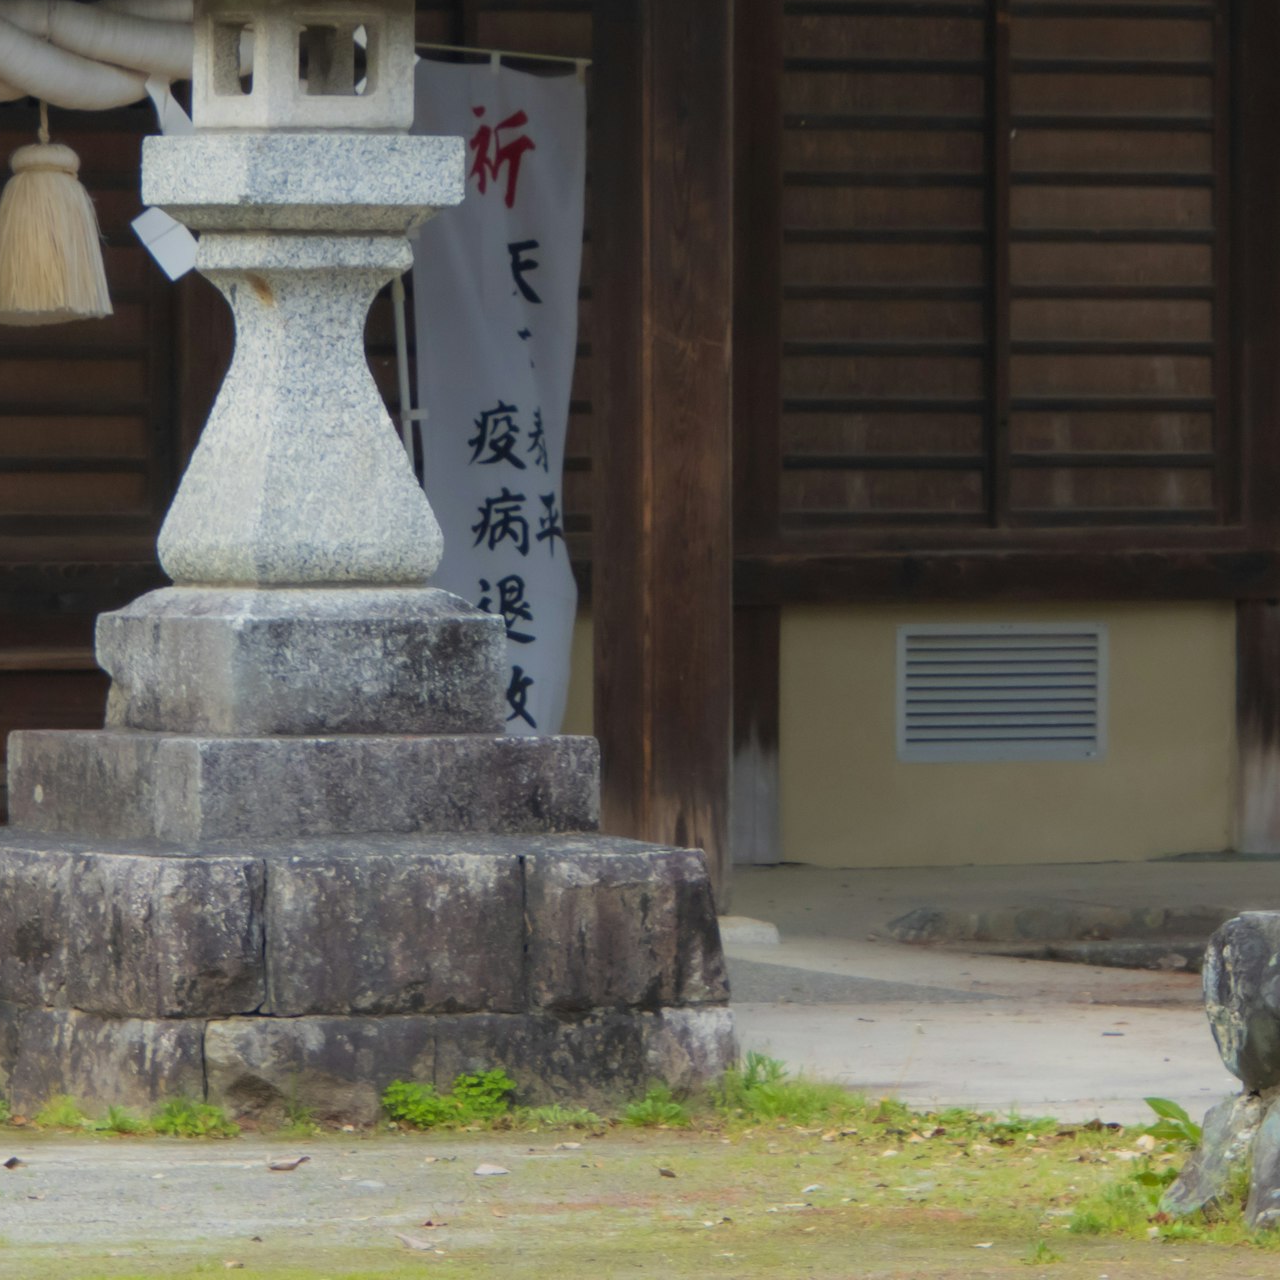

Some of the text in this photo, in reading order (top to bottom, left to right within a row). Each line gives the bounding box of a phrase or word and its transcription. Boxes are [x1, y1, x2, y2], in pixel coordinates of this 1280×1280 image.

[466, 106, 536, 209] 祈
[507, 239, 563, 559] 天泰平
